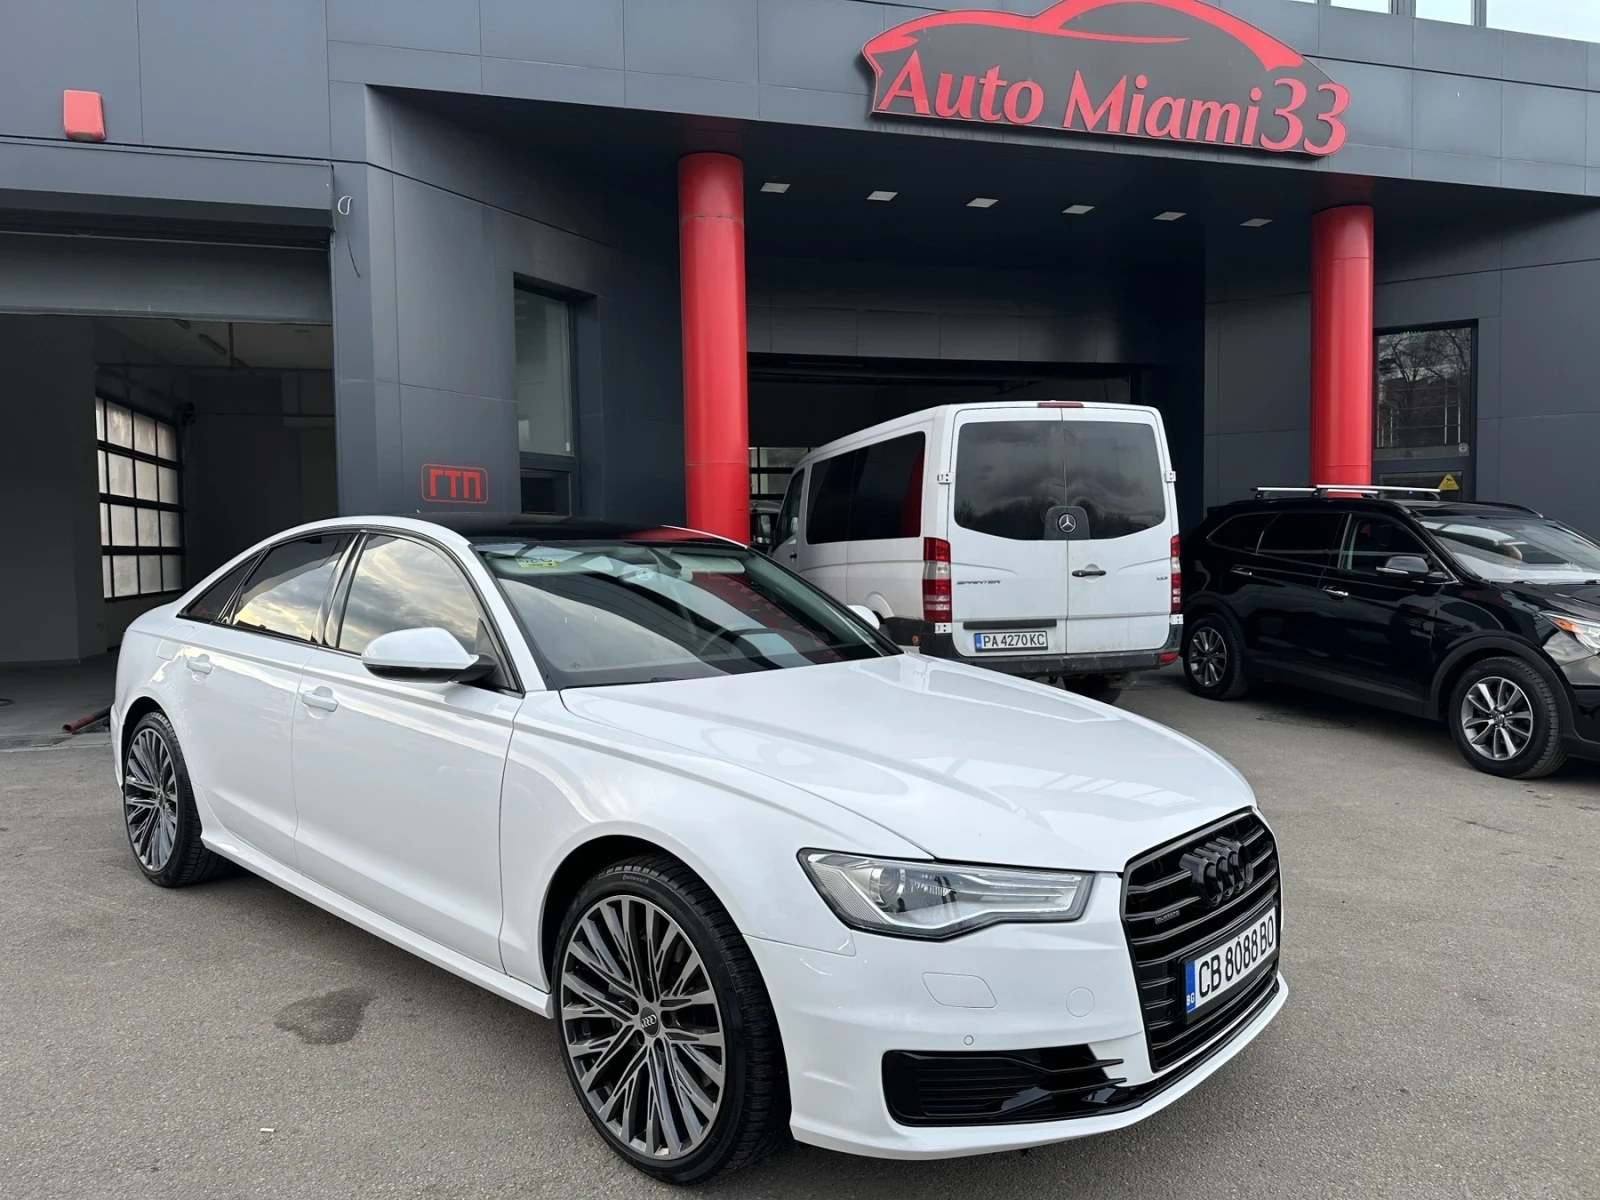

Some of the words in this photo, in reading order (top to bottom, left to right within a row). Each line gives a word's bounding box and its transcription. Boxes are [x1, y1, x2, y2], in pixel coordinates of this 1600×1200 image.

[878, 50, 1044, 124] Auto
[1062, 70, 1350, 155] Miami33
[1001, 634, 1028, 647] 4270
[1199, 954, 1222, 998] CB
[1225, 929, 1258, 982] 8088
